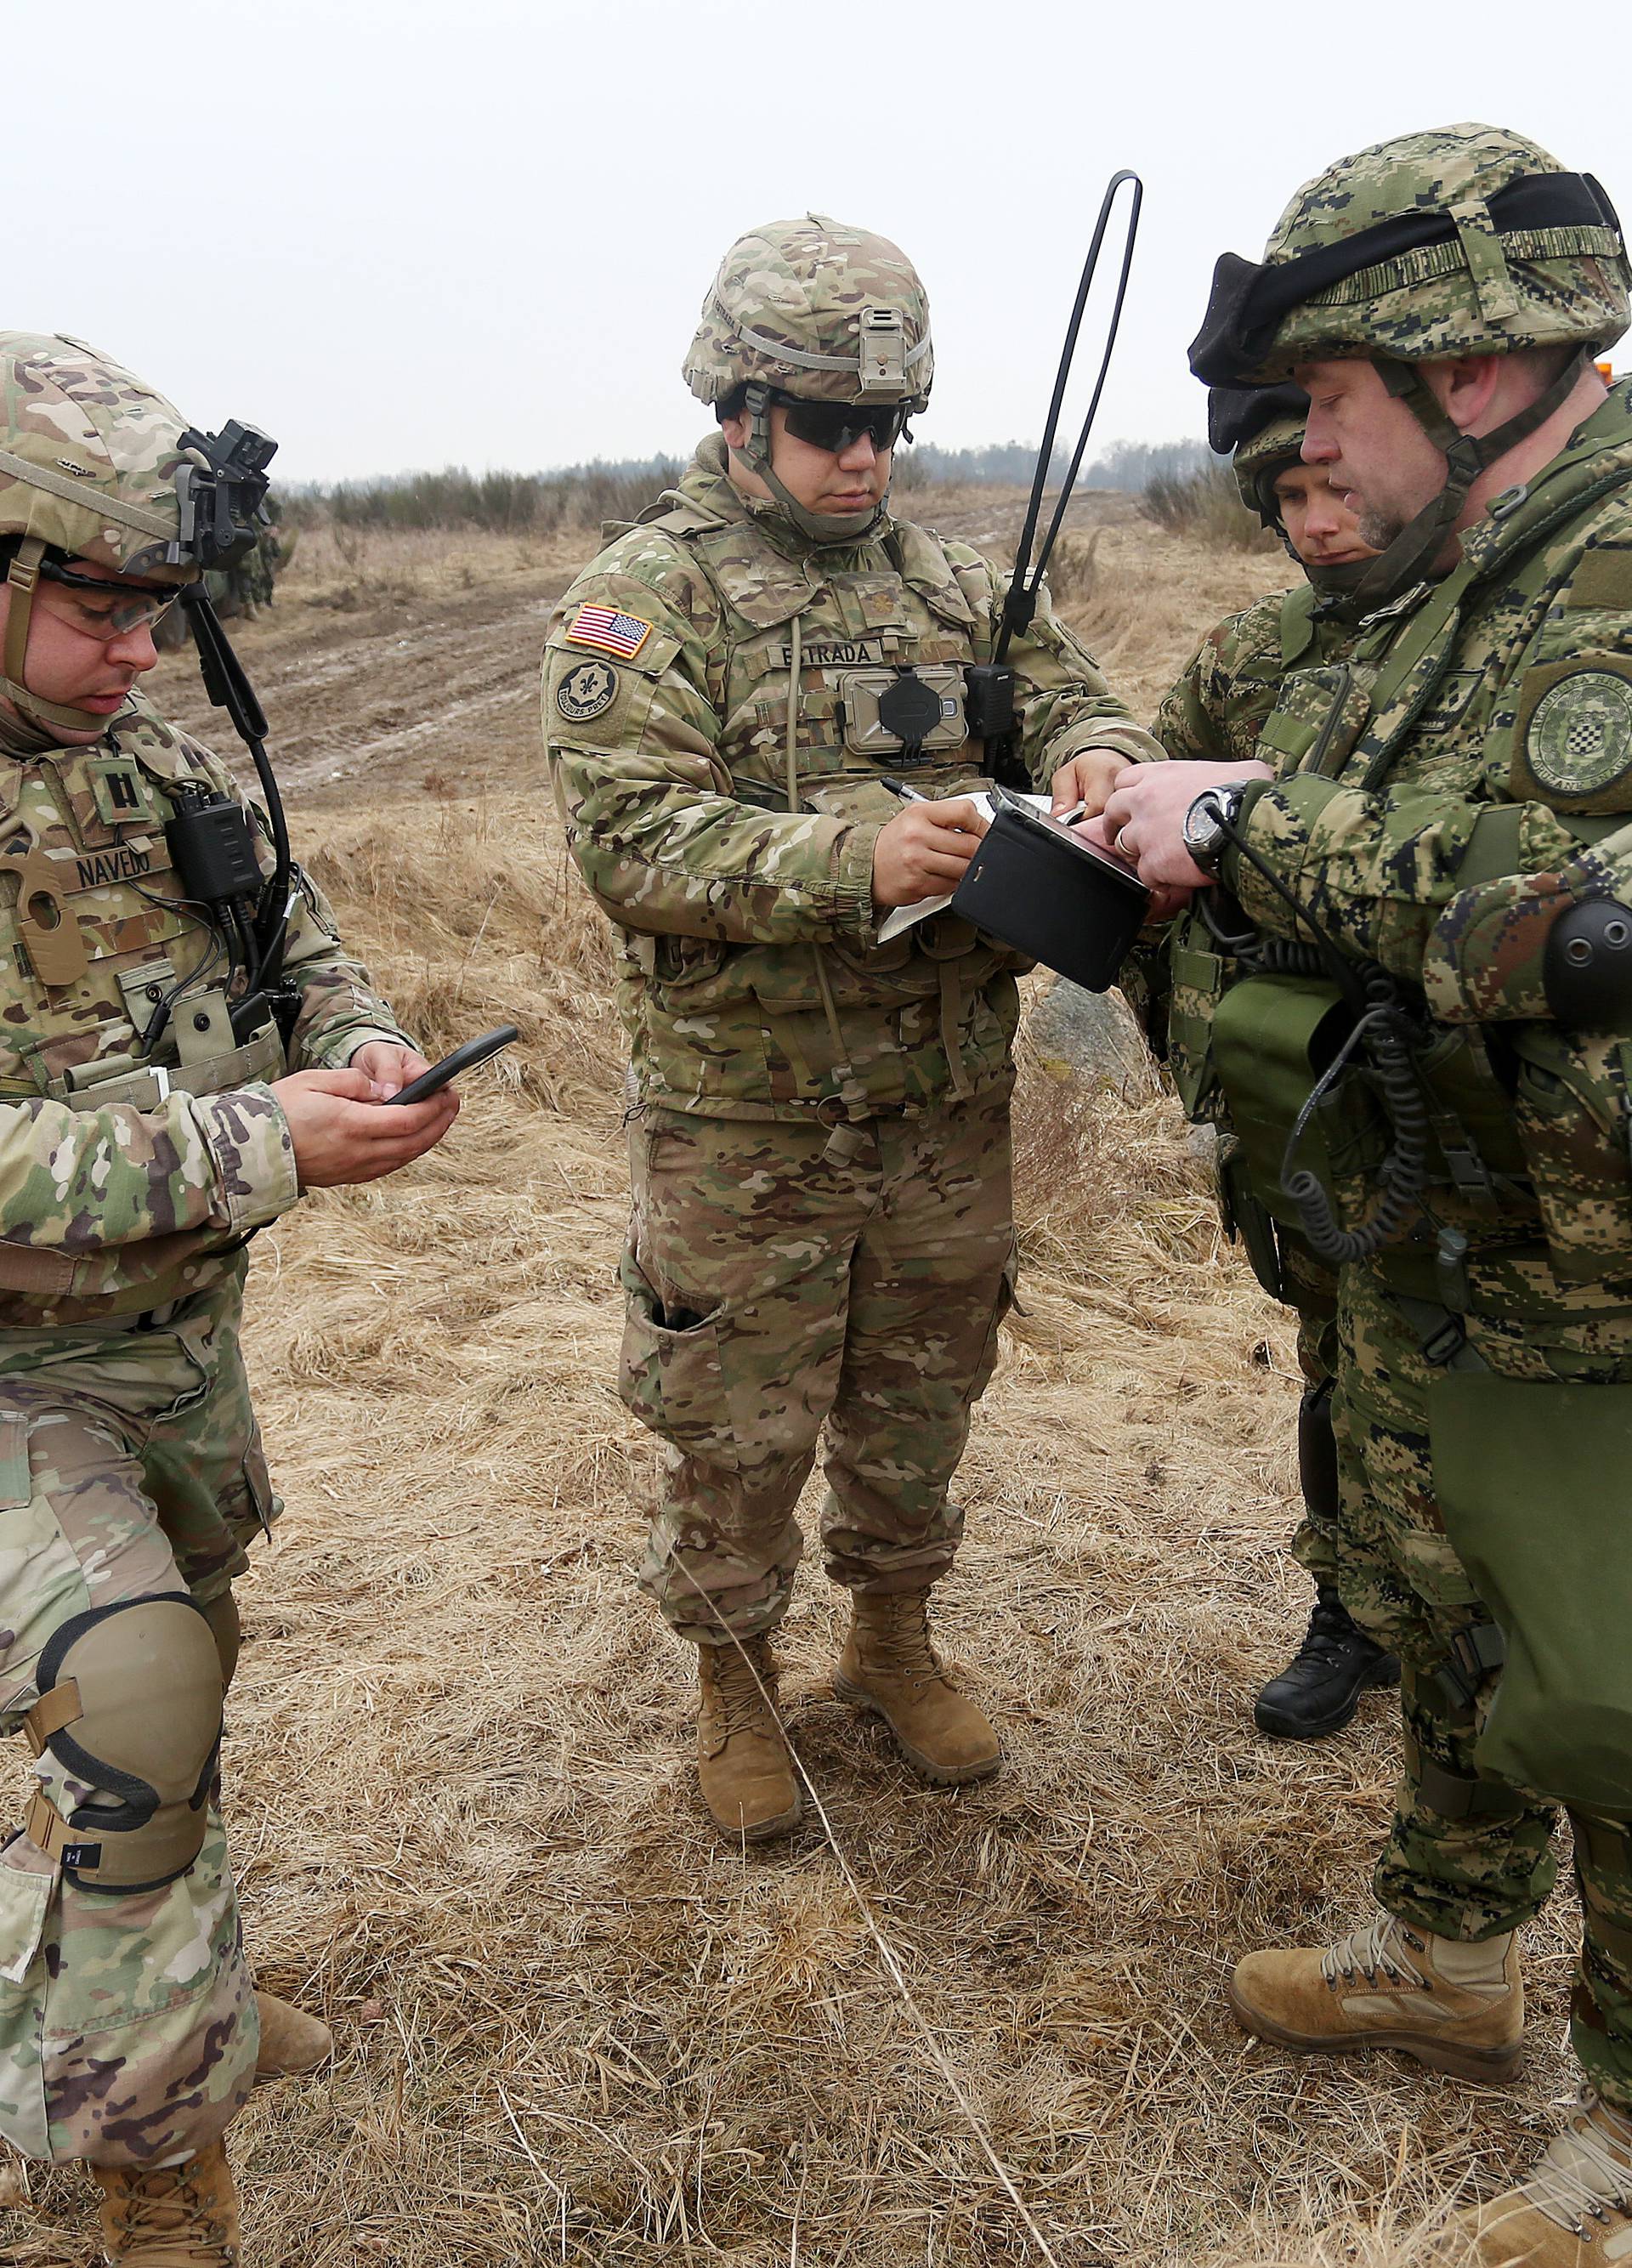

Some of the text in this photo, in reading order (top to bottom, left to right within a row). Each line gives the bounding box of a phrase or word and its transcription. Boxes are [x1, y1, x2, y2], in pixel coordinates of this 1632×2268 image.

[782, 643, 871, 666] ETRADA
[559, 690, 584, 715] TOUJOURS
[1533, 676, 1589, 729] REPUBLIKA
[76, 850, 150, 887] NAVEDO
